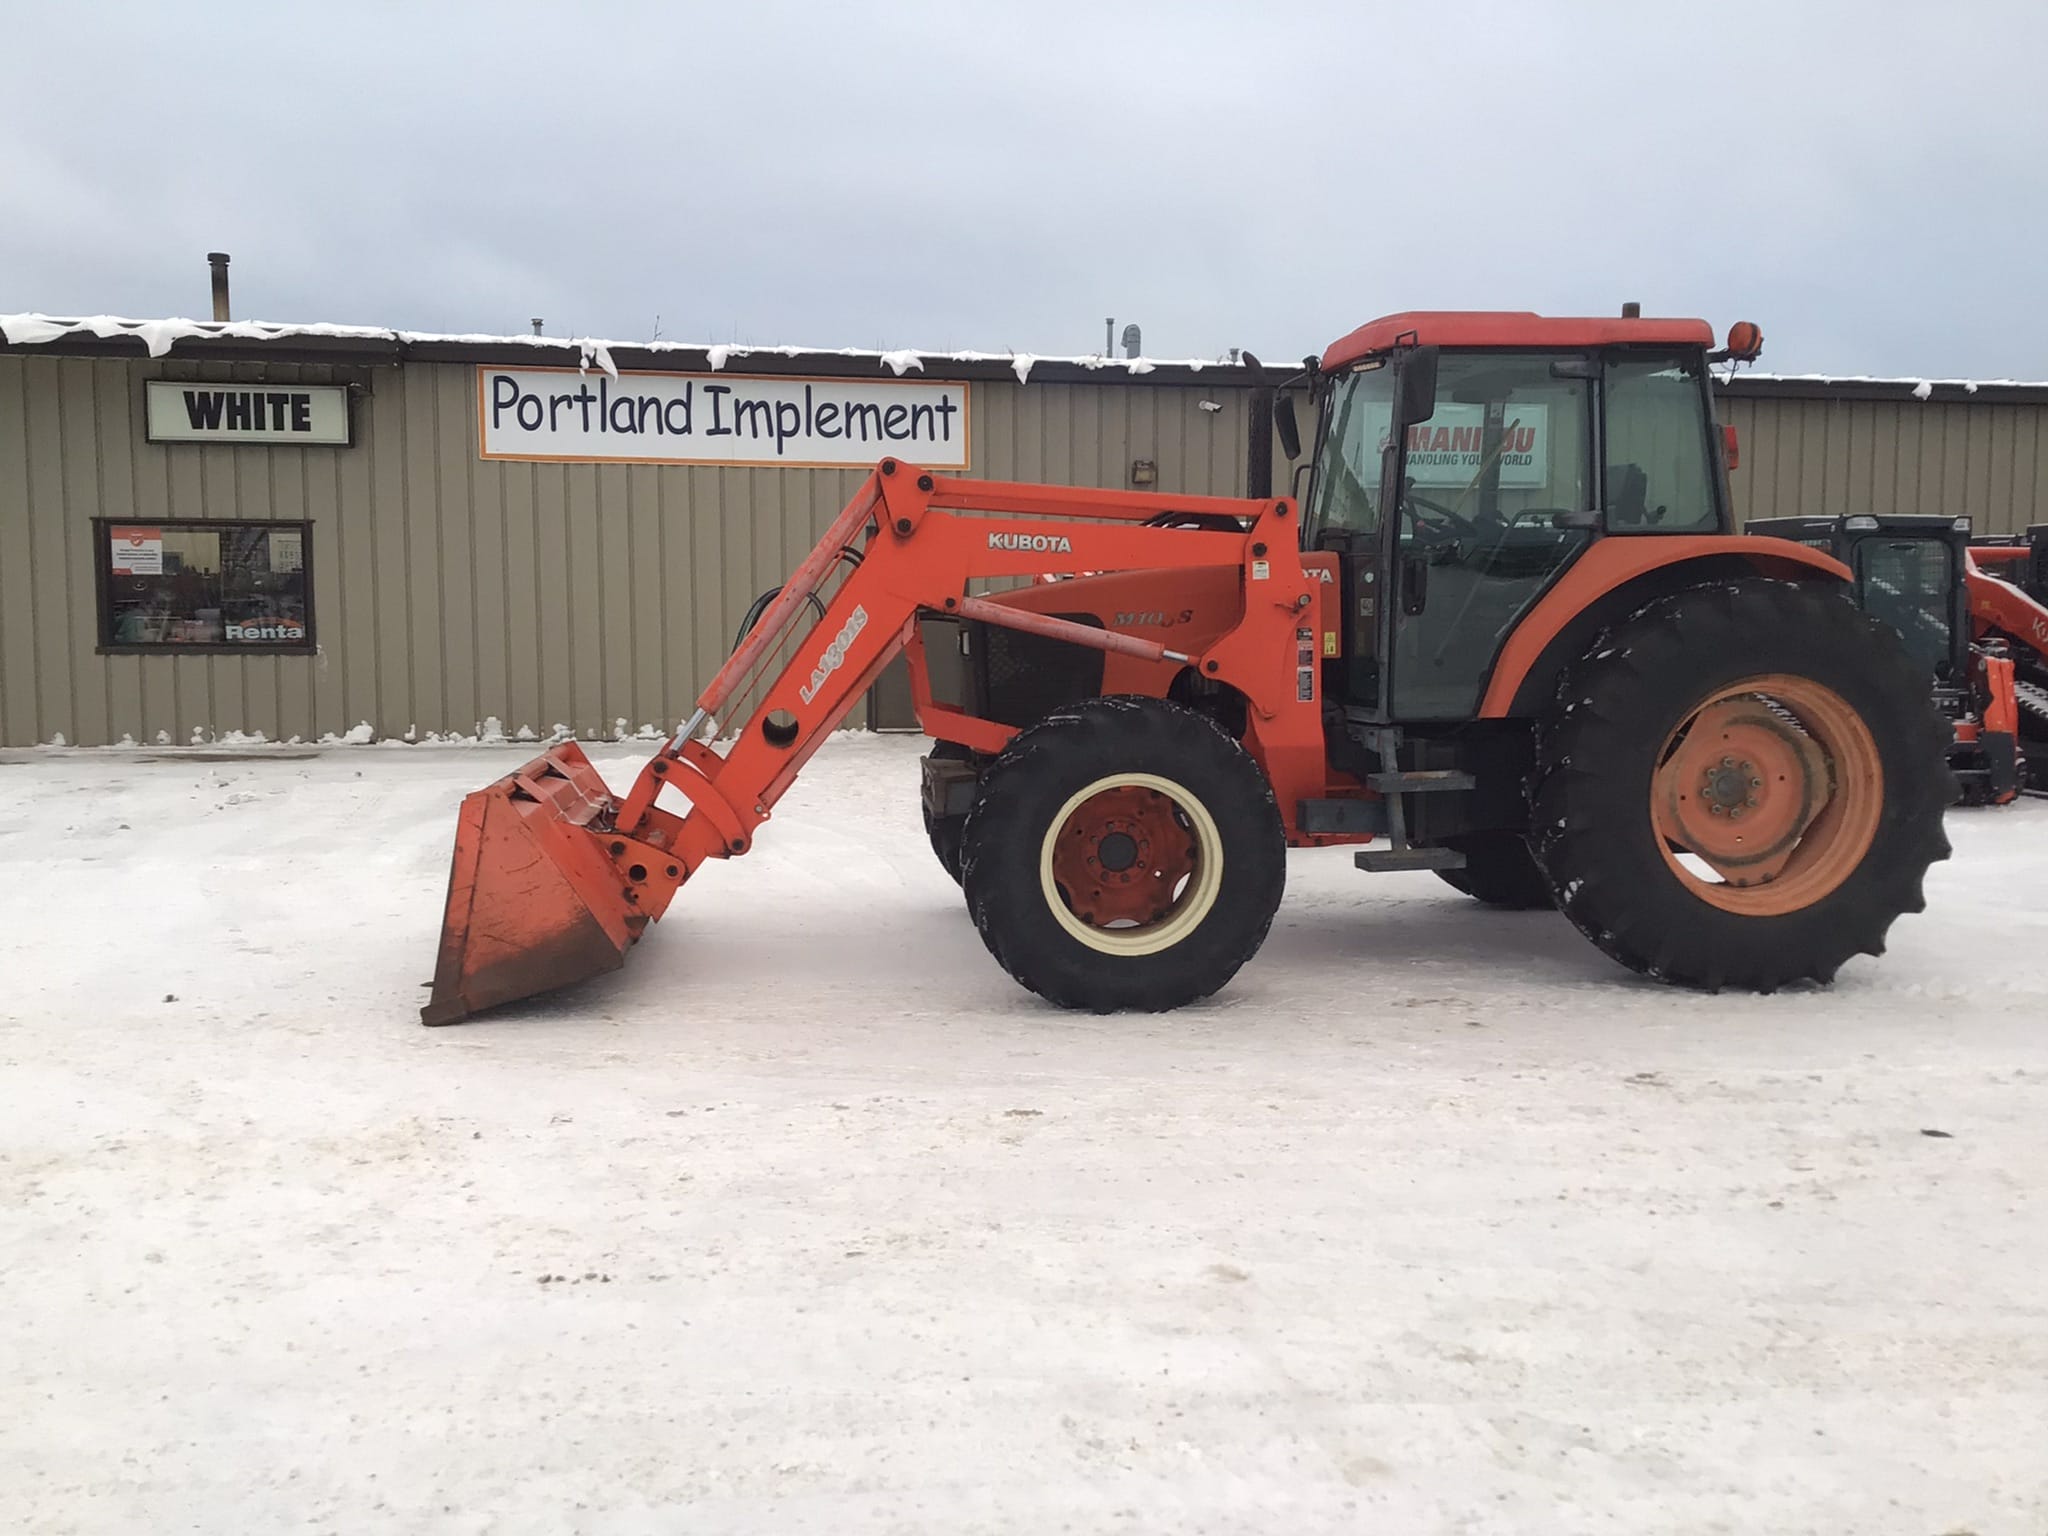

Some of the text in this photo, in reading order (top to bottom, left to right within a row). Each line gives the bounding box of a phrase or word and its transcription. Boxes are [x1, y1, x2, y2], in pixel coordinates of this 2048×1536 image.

[183, 391, 311, 432] WHITE
[492, 375, 957, 455] Portland Implement
[1406, 426, 1536, 453] MANIOU
[988, 532, 1072, 553] KUBOTA
